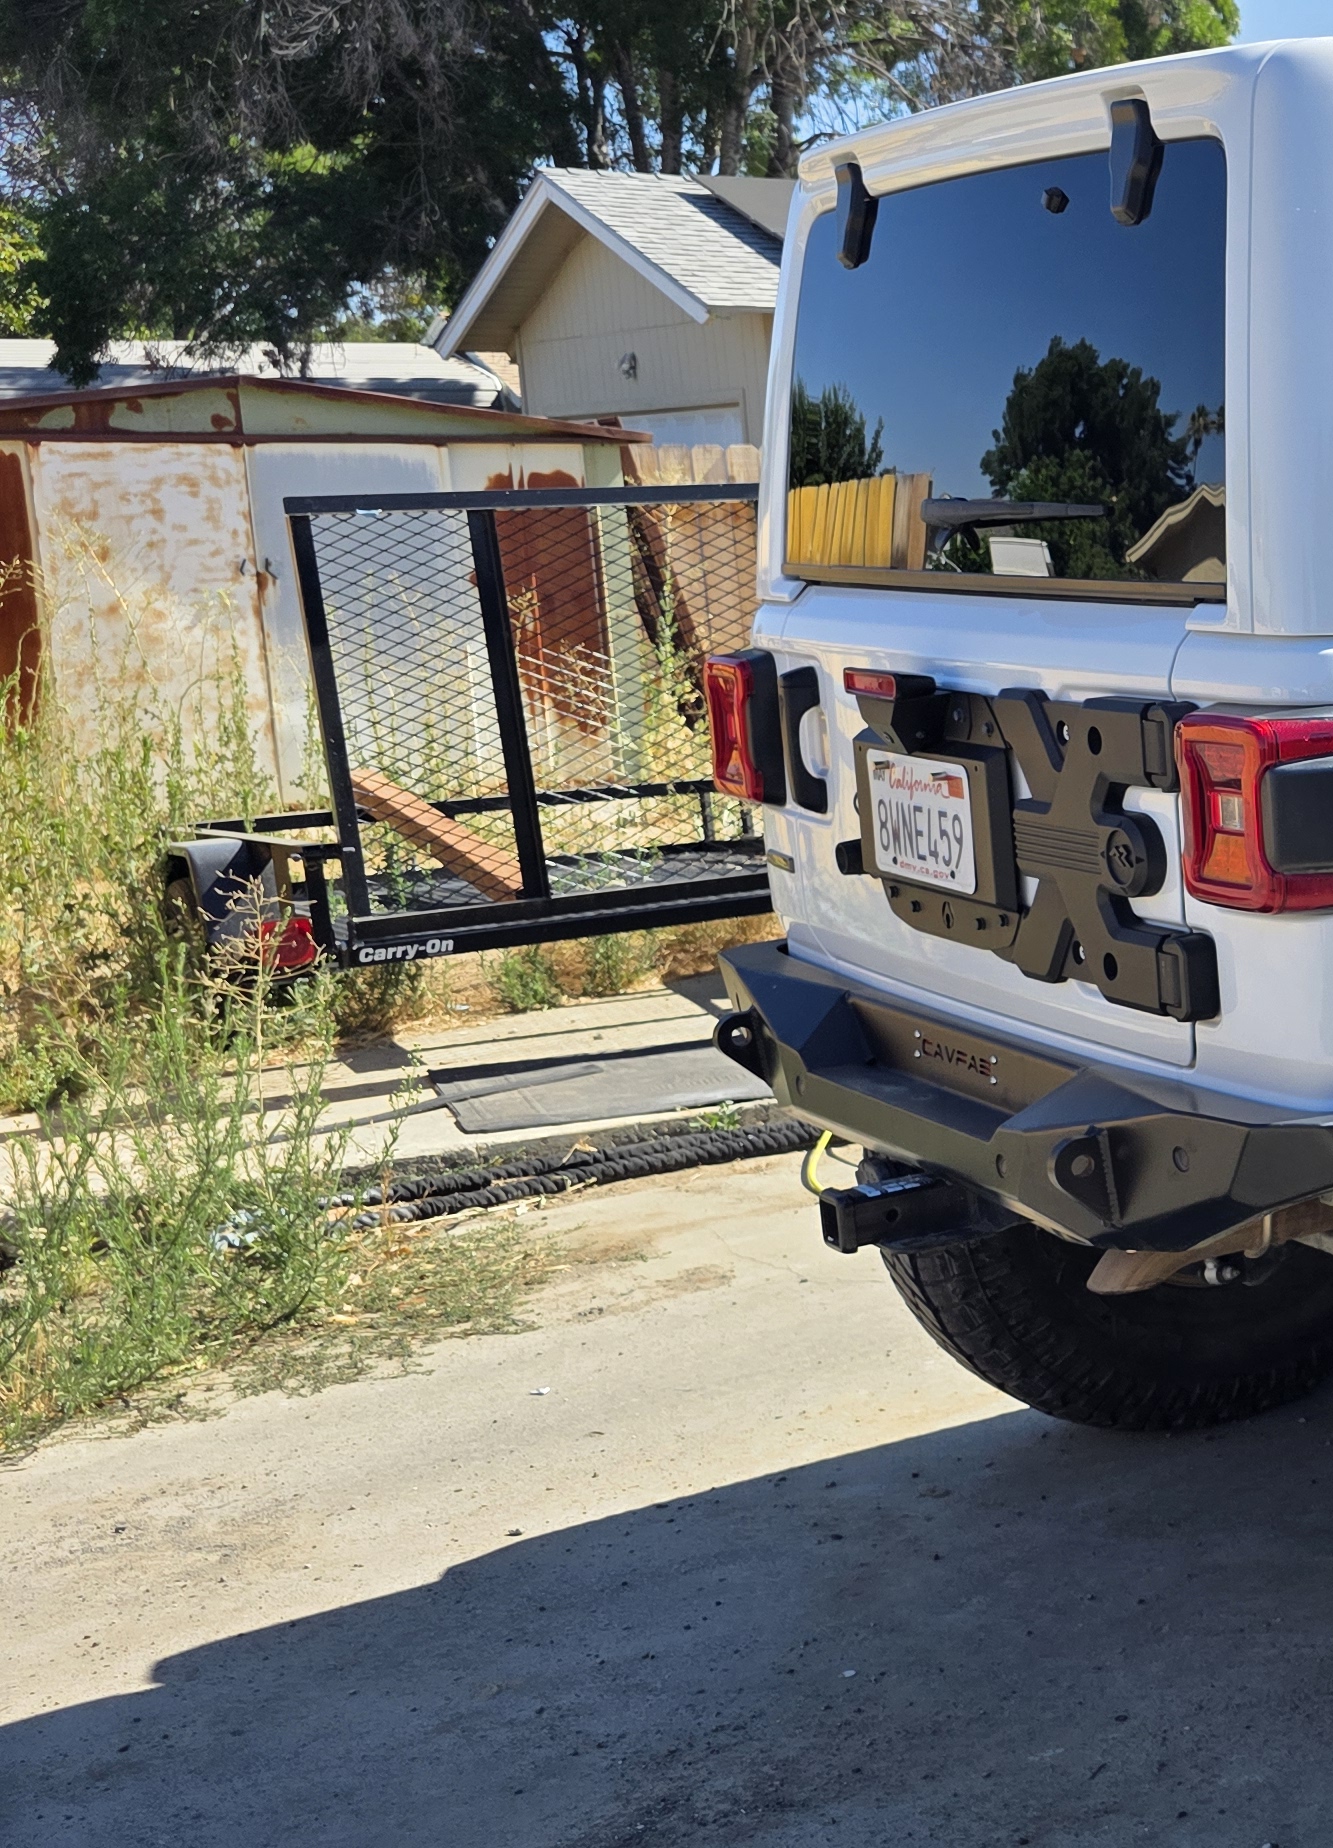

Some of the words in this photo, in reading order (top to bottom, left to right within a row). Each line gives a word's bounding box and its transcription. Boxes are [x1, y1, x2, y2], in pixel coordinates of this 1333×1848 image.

[888, 762, 950, 800] California
[878, 798, 964, 870] 8WNE459
[899, 860, 951, 880] dmv.ca.gov
[358, 939, 455, 963] Carry-On
